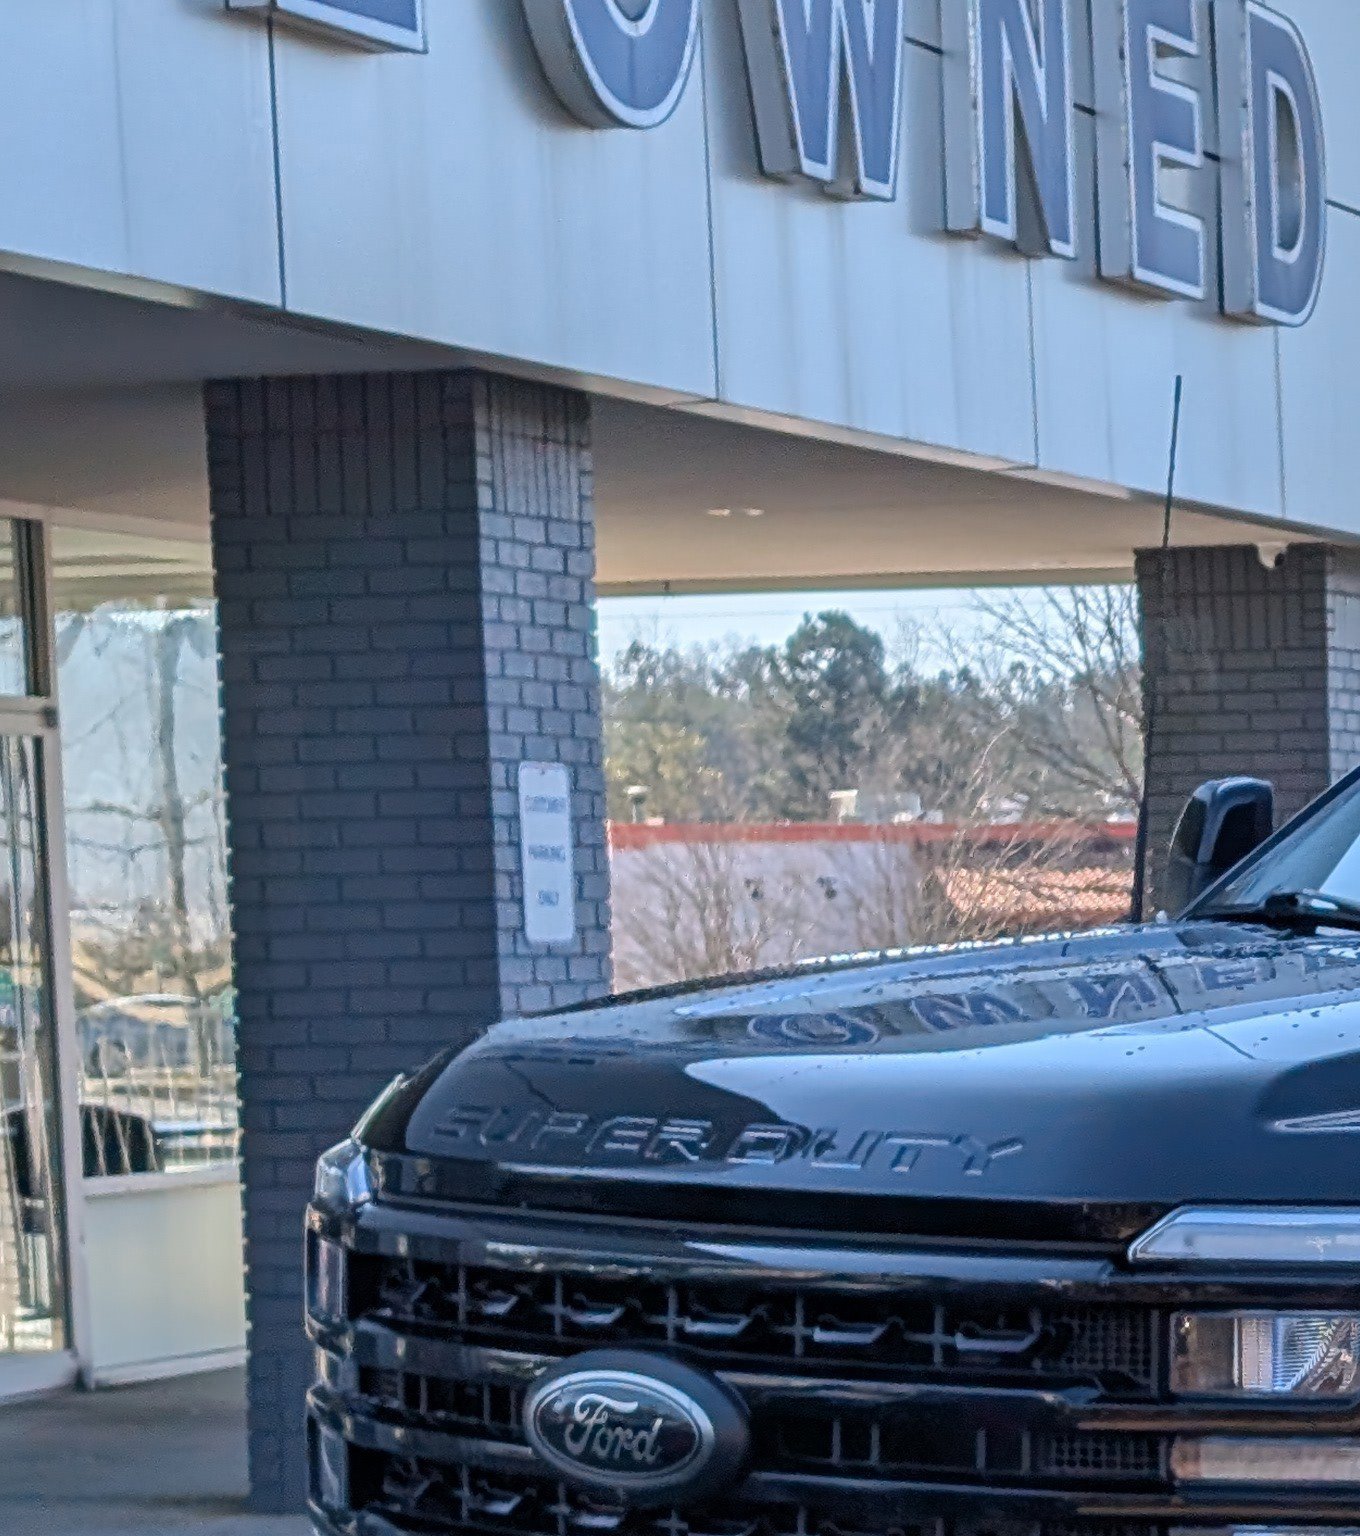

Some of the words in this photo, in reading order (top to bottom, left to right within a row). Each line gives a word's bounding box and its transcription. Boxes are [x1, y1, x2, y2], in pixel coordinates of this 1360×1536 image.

[540, 0, 1325, 327] WNED
[434, 1102, 713, 1162] SUPER
[728, 1122, 1026, 1178] DUTY
[563, 1393, 664, 1464] Ford
